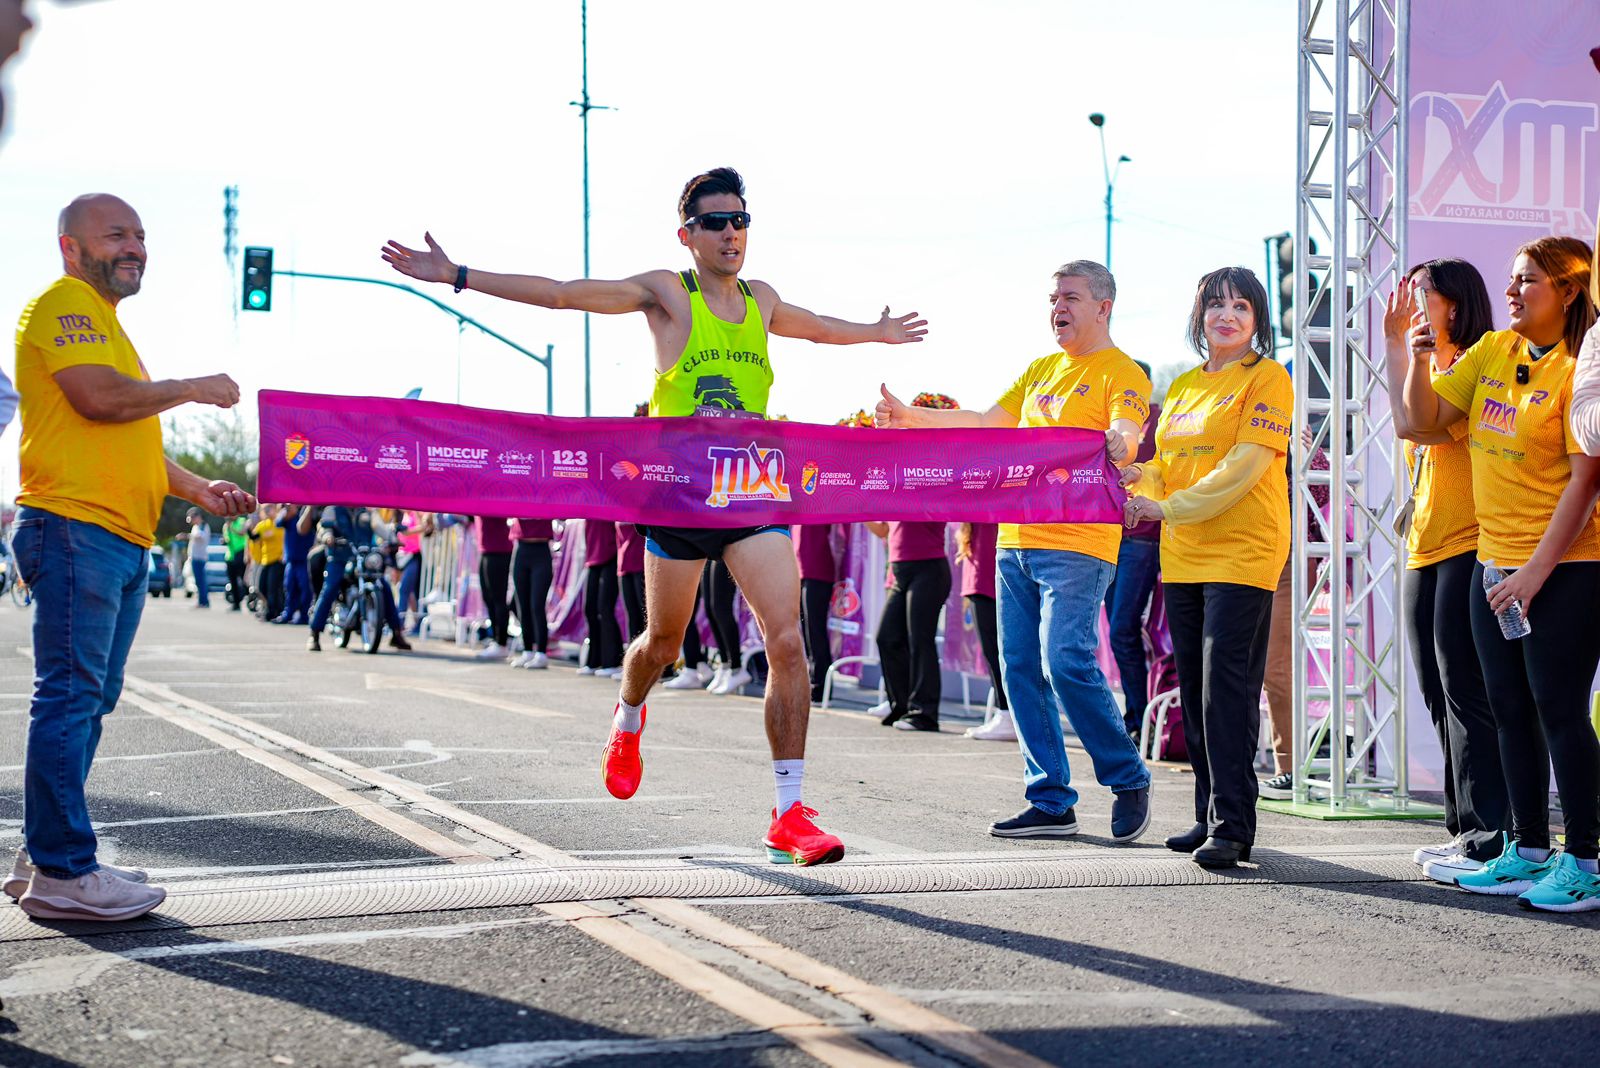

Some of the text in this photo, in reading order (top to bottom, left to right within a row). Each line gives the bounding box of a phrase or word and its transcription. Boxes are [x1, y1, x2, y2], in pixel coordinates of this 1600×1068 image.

[54, 333, 108, 347] STAFF
[683, 349, 720, 373] CLUB
[1251, 418, 1290, 436] STAFF
[314, 446, 359, 455] GOBIERNO
[427, 446, 489, 459] IMDECUF
[327, 454, 367, 462] MEXICALI
[552, 449, 589, 466] 123
[642, 464, 674, 473] WORLD
[903, 467, 954, 478] IMDECUF
[1006, 464, 1035, 479] 123
[642, 474, 690, 483] ATHLETICS
